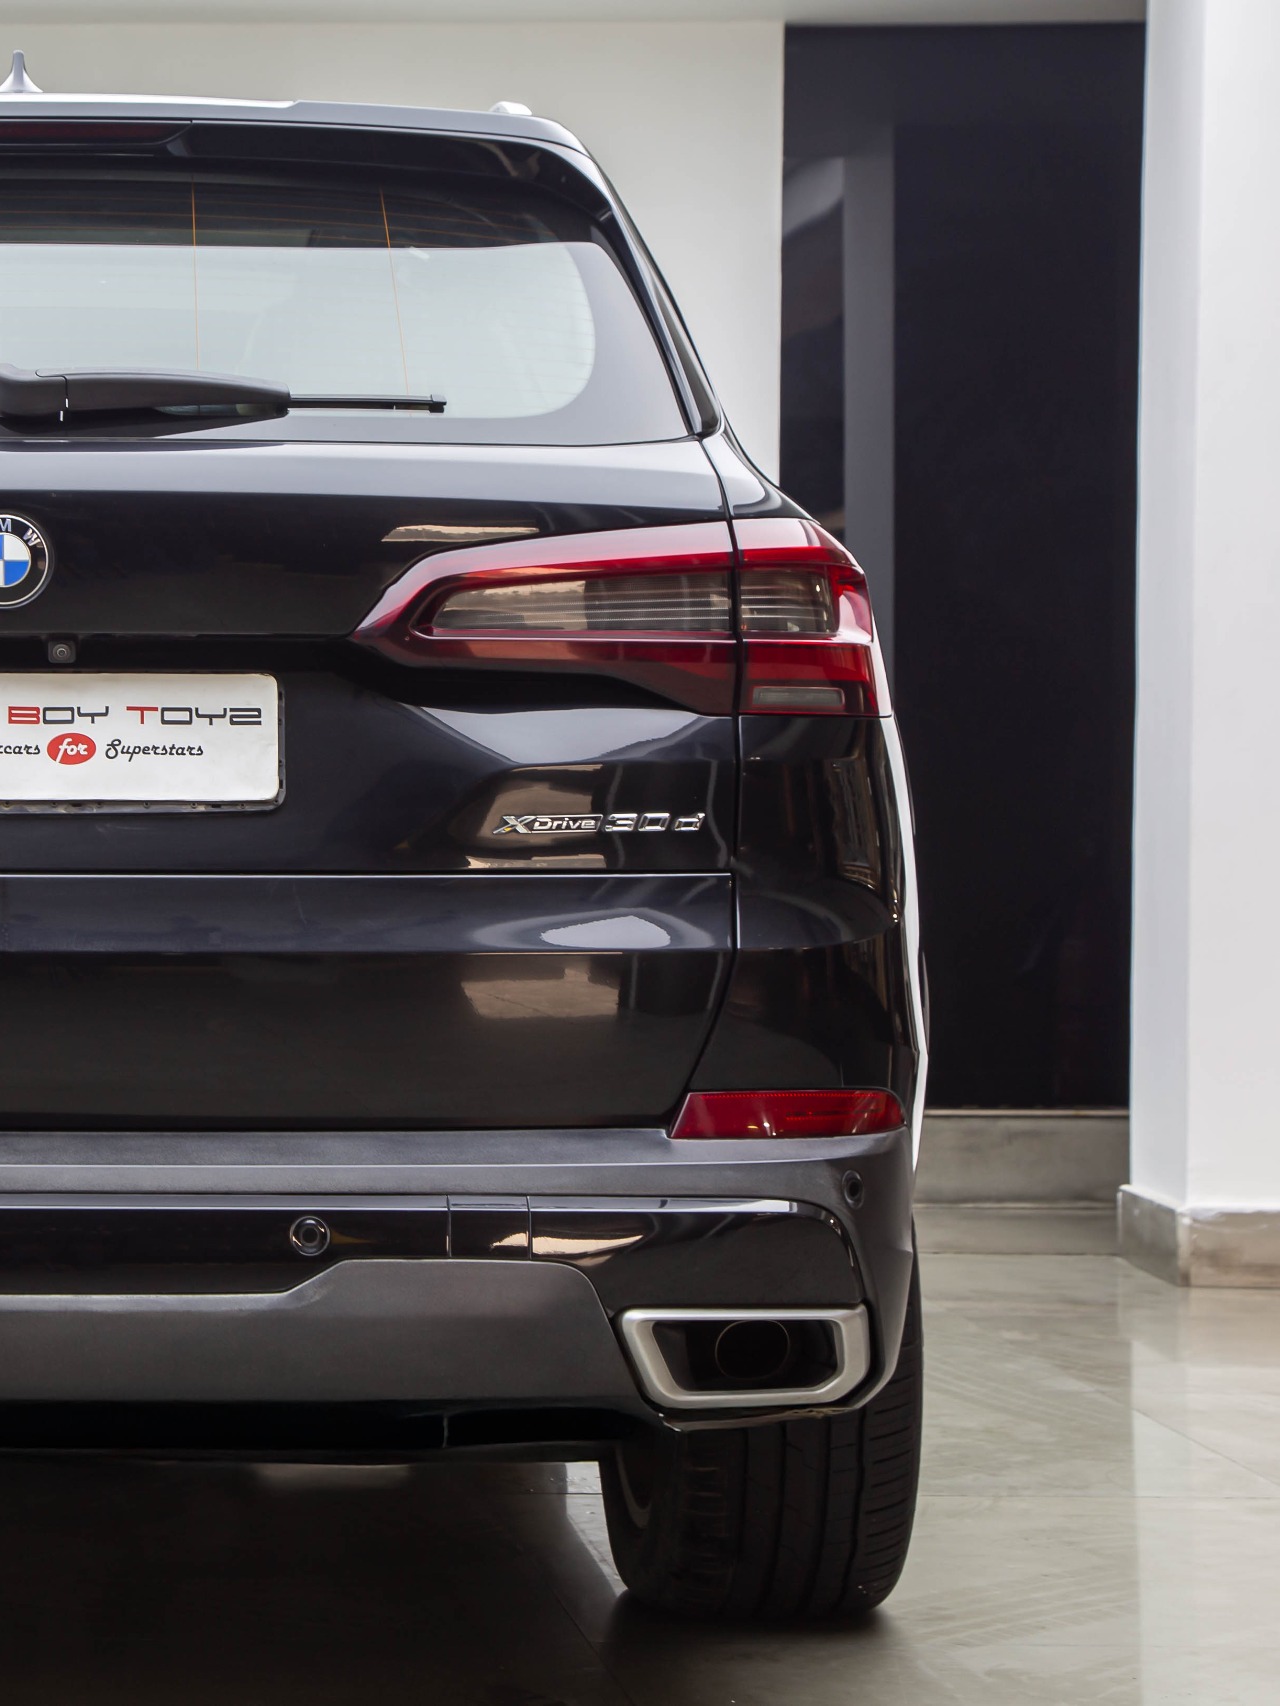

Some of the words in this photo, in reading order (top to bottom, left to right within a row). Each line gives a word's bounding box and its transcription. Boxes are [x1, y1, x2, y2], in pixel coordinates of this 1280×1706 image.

[8, 706, 109, 725] BOY
[55, 737, 88, 764] for
[105, 738, 204, 762] Superstars
